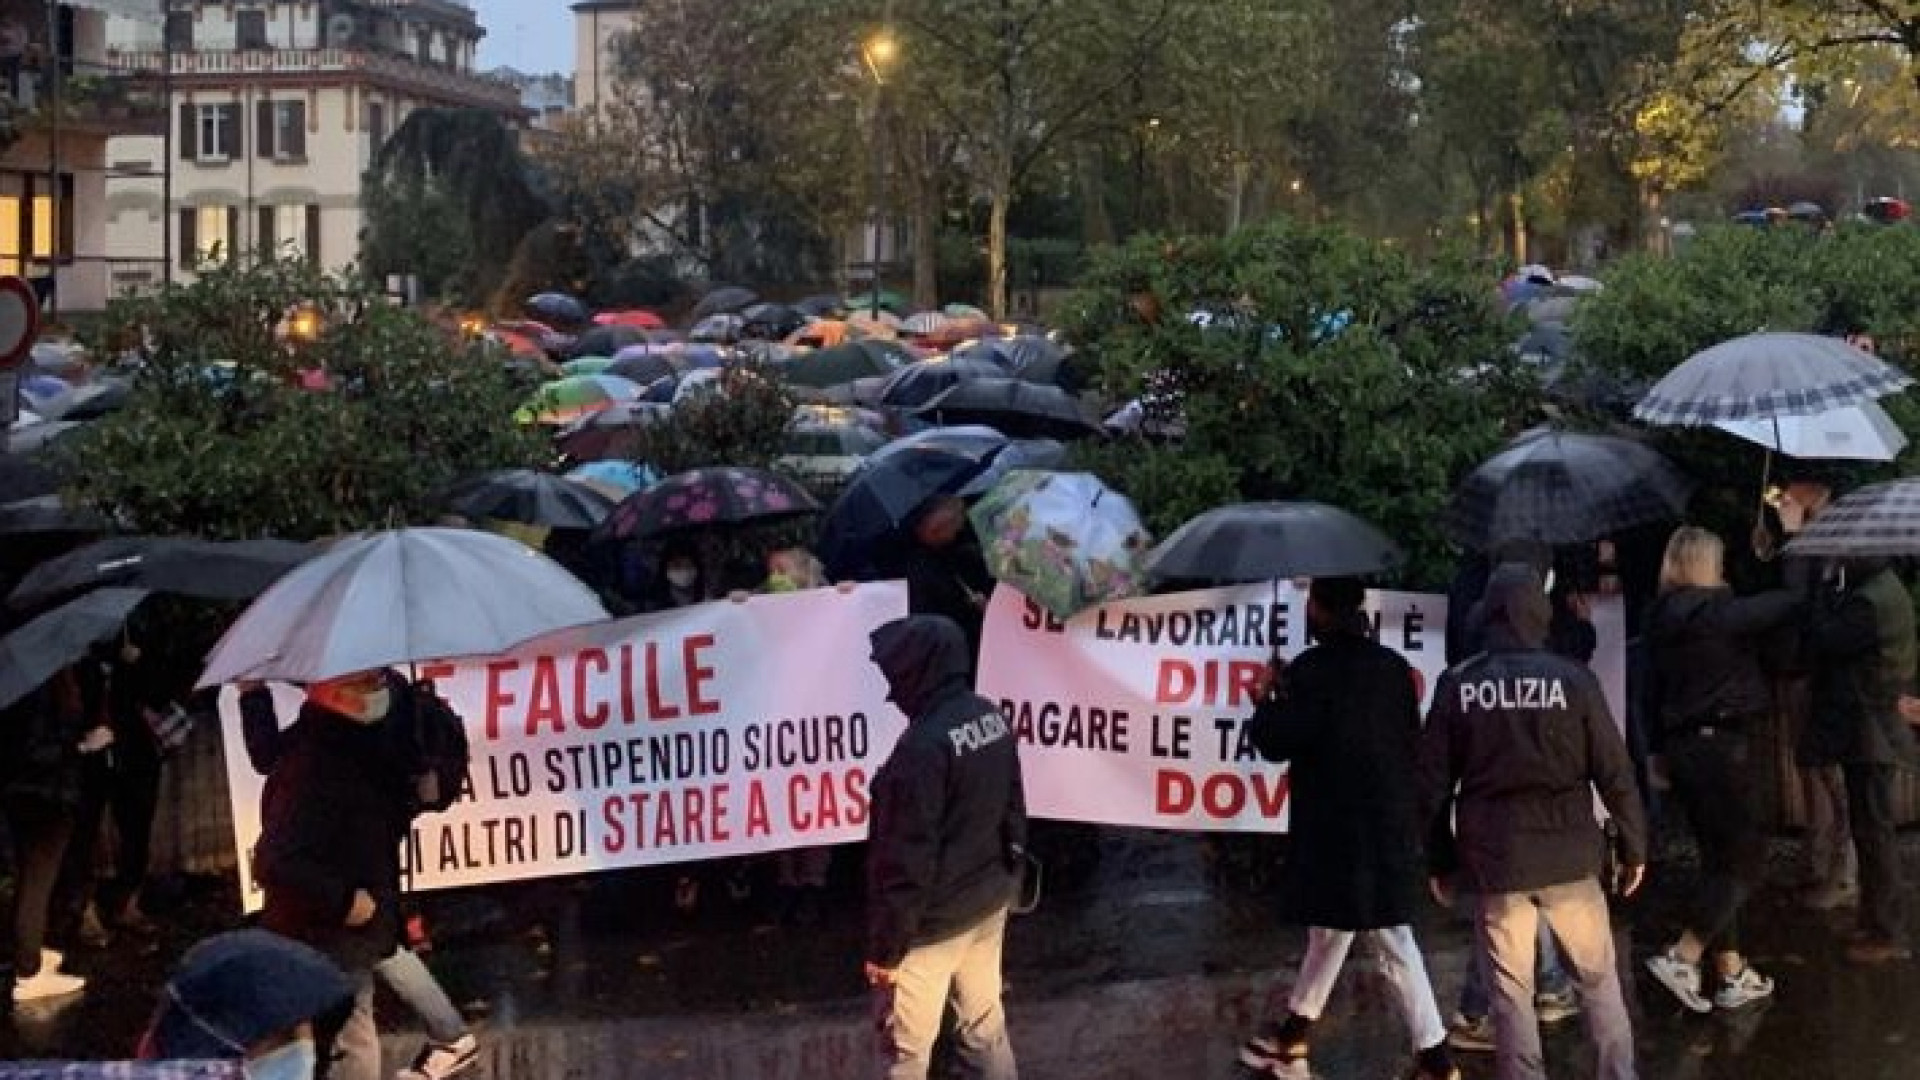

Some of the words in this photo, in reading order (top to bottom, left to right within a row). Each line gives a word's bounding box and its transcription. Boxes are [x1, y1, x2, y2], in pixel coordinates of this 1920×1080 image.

[1096, 604, 1289, 647] LAVORARE
[486, 635, 718, 741] FACILE
[1460, 677, 1567, 713] POLIZIA
[489, 752, 531, 800] LO
[544, 728, 730, 794] STIPENDIO
[744, 712, 868, 772] SICURO
[1151, 715, 1192, 760] LE
[1213, 717, 1257, 762] TA
[1155, 769, 1291, 819] DOV
[438, 814, 538, 873] ALTRI
[555, 809, 587, 859] DI
[604, 783, 730, 853] STARE
[745, 779, 771, 838] A
[787, 768, 869, 832] CAS
